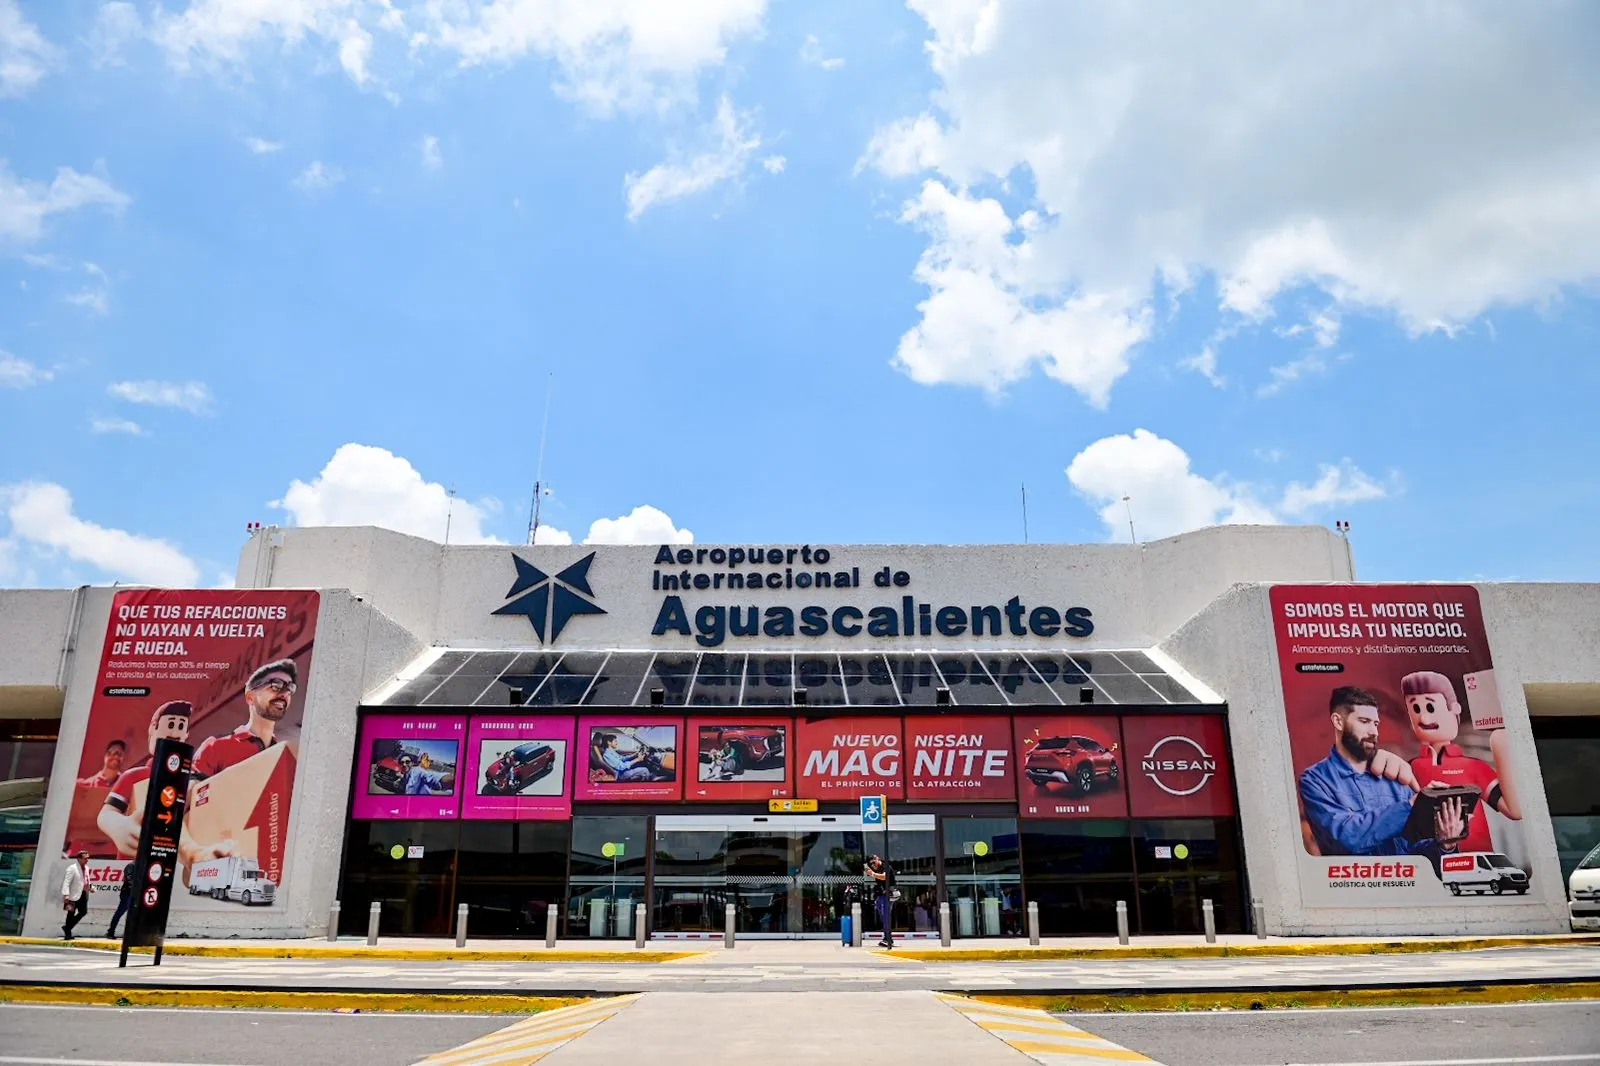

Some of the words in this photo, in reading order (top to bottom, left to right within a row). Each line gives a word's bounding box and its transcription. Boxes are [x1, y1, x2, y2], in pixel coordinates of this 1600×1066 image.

[654, 545, 831, 567] Aeropuerto
[653, 567, 860, 590] Internacional
[874, 567, 910, 587] de
[119, 605, 149, 619] QUE
[153, 605, 181, 619] TUS
[185, 605, 287, 620] REFACCIONES
[1284, 603, 1344, 618] SOMOS
[1348, 603, 1368, 617] EL
[1371, 603, 1428, 617] MOTOR
[1433, 603, 1465, 619] QUE
[651, 595, 1095, 646] Aguascalientes
[115, 623, 137, 637] NO
[141, 623, 191, 637] VAYAN
[193, 624, 205, 637] A
[210, 624, 264, 638] VUELTA
[1287, 623, 1363, 638] IMPULSA
[1365, 623, 1387, 637] TU
[1391, 623, 1467, 638] NEGOCIO.
[112, 641, 131, 655] DE
[134, 641, 188, 656] RUEDA.
[1292, 644, 1353, 654] Almacenamos
[1356, 646, 1361, 655] y
[1363, 644, 1417, 654] distribuimos
[1419, 644, 1470, 655] autopartes.
[108, 661, 145, 669] Reducimos
[147, 661, 167, 669] hasta
[179, 661, 195, 669] 30%
[196, 661, 203, 669] el
[204, 661, 230, 671] tiempo
[146, 671, 155, 679] de
[156, 671, 168, 679] tus
[109, 687, 145, 695] estafeta.com
[1475, 717, 1504, 726] estafeta
[832, 734, 897, 747] NUEVO
[914, 734, 983, 747] NISSAN
[170, 757, 179, 768] 20
[803, 749, 900, 777] MAG
[913, 749, 1008, 777] NITE
[1142, 760, 1216, 770] NISSAN
[835, 780, 885, 788] PRINCIPIO
[913, 780, 925, 788] LA
[927, 779, 981, 788] ATRACCIÓN
[269, 792, 280, 853] estafétalo
[196, 867, 219, 878] estafeta
[269, 857, 280, 884] ejor
[1327, 862, 1415, 878] estafeta
[1329, 880, 1366, 888] LOGÍSTICA
